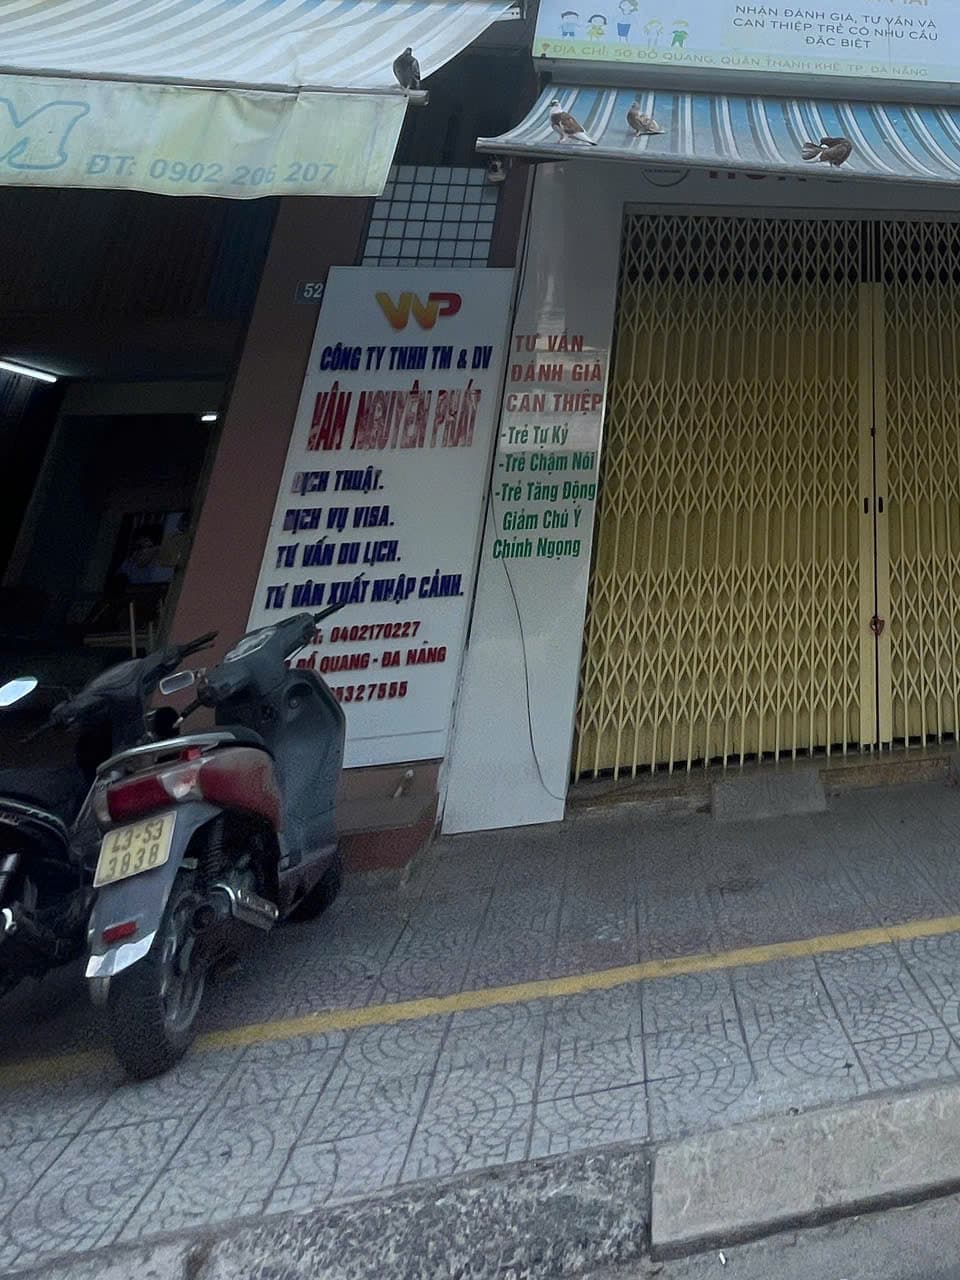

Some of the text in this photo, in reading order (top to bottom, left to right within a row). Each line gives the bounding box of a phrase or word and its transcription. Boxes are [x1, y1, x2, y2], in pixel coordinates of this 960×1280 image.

[733, 17, 765, 28] CAN
[149, 159, 219, 183] 0902
[284, 162, 338, 184] 207
[303, 283, 324, 298] 52
[514, 332, 539, 353] TƯ
[320, 342, 493, 370] CÔNG TY TNHH TM & DV
[506, 388, 603, 416] CAN THIỆP
[530, 452, 568, 476] Chậm
[572, 451, 596, 470] Nói
[527, 481, 559, 502] Tăng
[562, 481, 596, 504] Động
[326, 507, 350, 532] VỤ
[503, 508, 538, 531] Giảm
[301, 535, 336, 567] VẤN
[337, 542, 361, 565] DU
[537, 538, 581, 561] Ngọng
[371, 573, 417, 604] NHẬP
[330, 621, 421, 643] 0402170227
[320, 654, 370, 674] QUANG
[330, 680, 409, 703] 5327555
